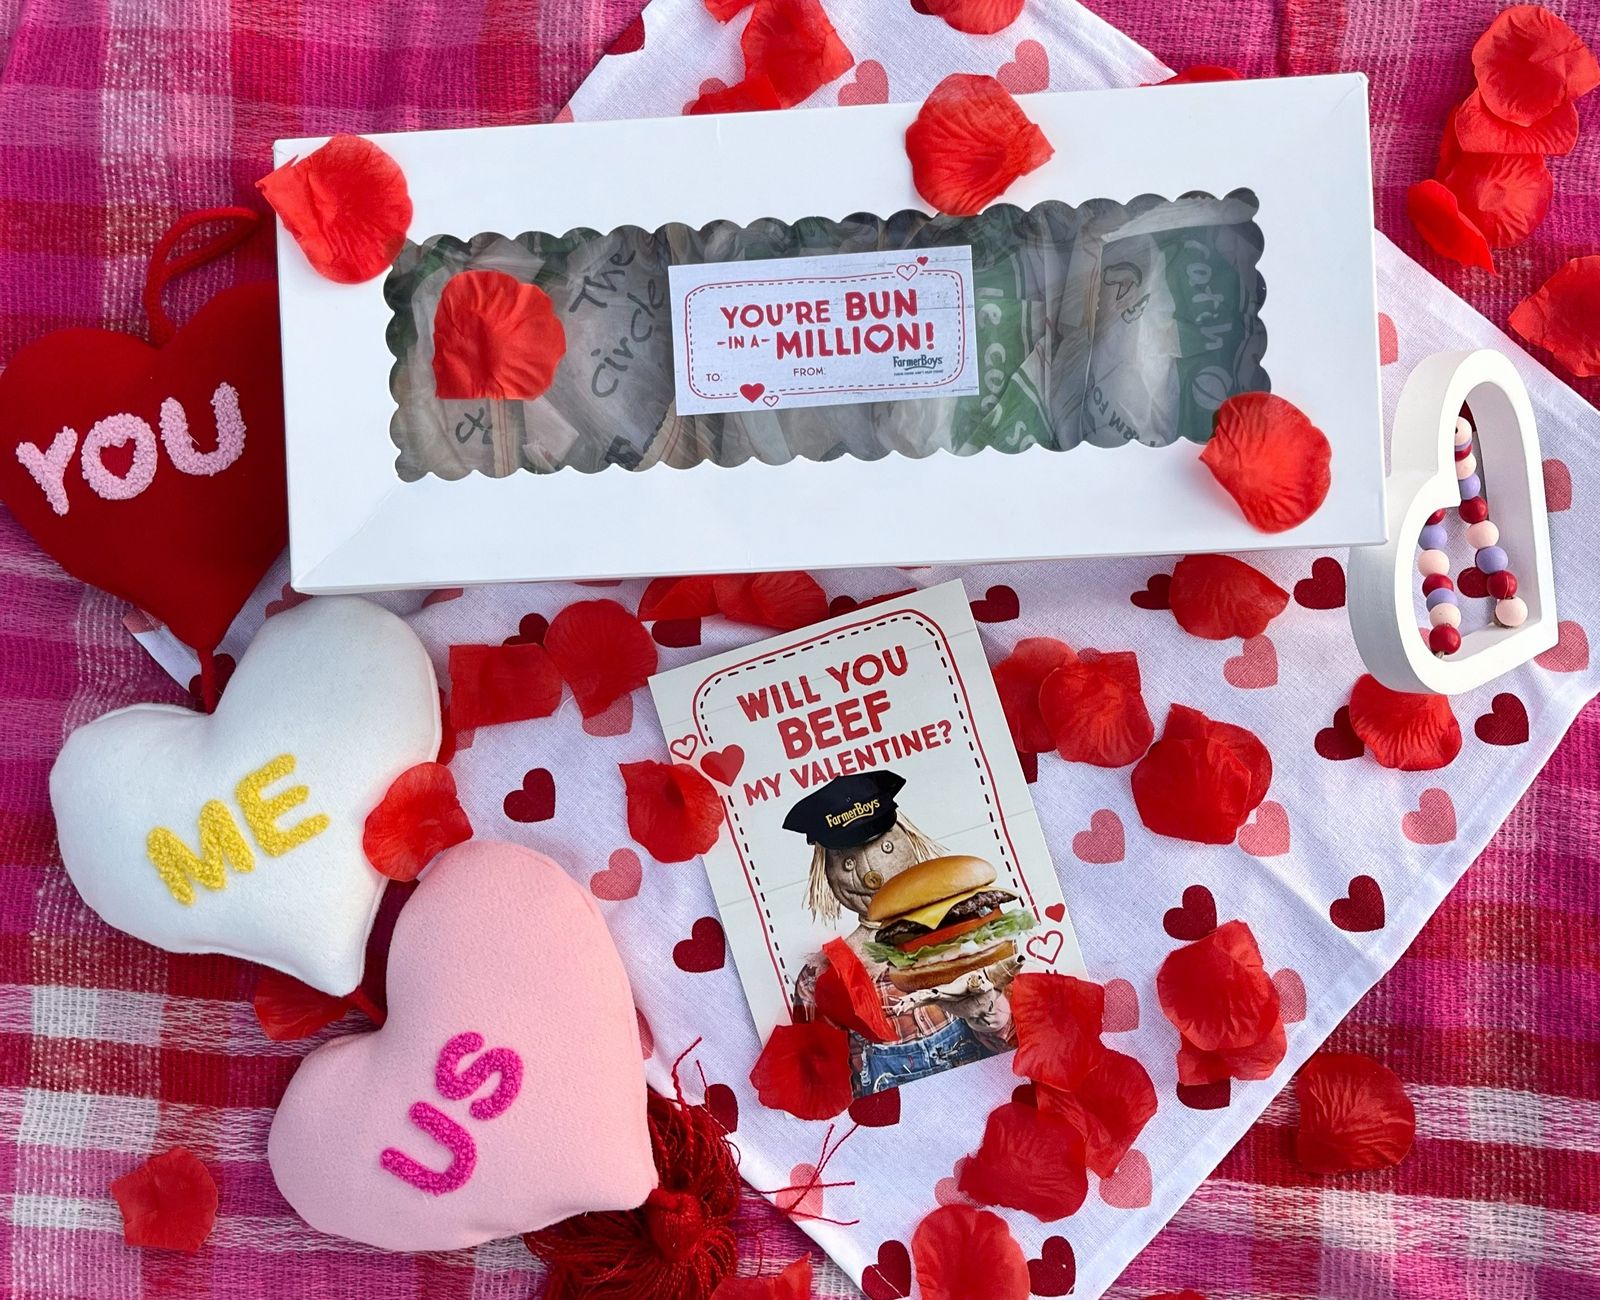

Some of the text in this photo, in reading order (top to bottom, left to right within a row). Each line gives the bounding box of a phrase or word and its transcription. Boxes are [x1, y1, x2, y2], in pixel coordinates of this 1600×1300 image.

[568, 249, 636, 313] The
[720, 289, 918, 329] YOU'RE BUN
[591, 279, 665, 398] Circle
[776, 322, 935, 360] MILLION!
[893, 353, 944, 372] FarmerBoys
[705, 366, 826, 382] TO: FROM:
[16, 382, 247, 516] YOU
[737, 645, 908, 721] WILL YOU
[777, 690, 891, 760] BEEF
[743, 719, 952, 806] MY VALENTINE?
[147, 753, 330, 906] ME
[825, 798, 880, 828] FarmerBoys
[380, 1031, 525, 1197] US
